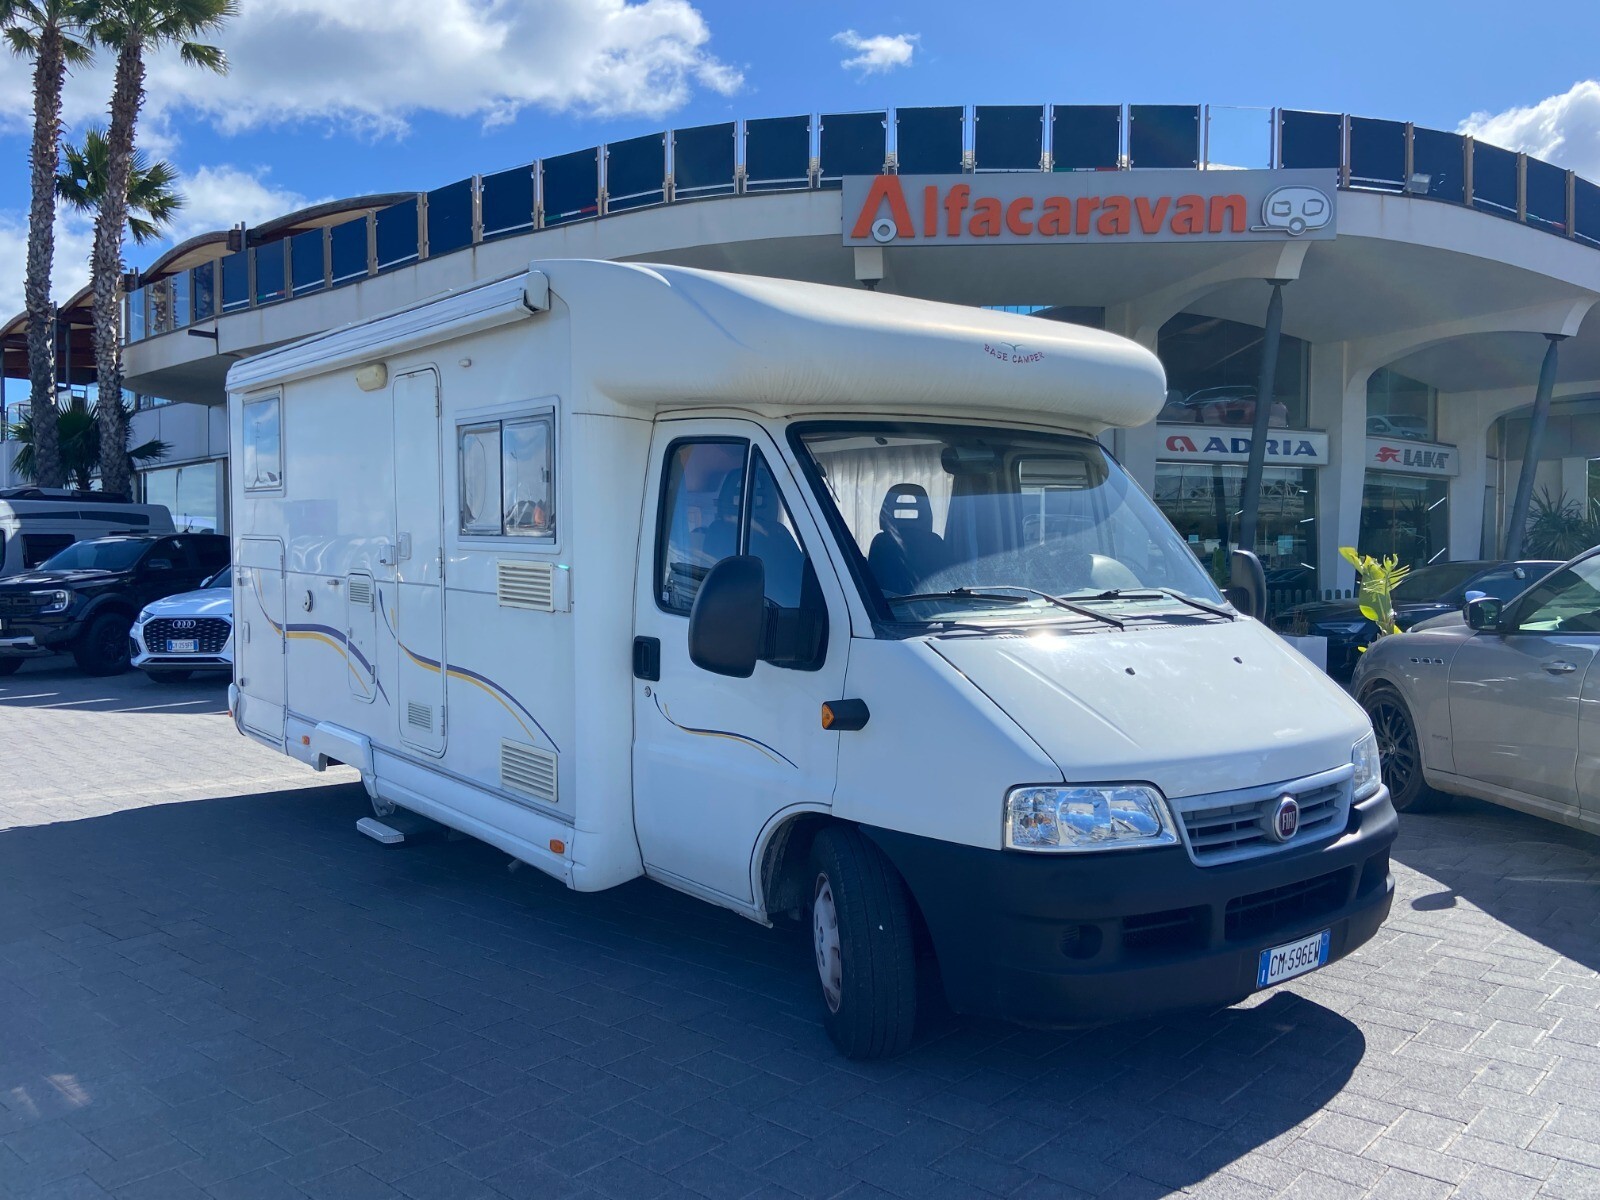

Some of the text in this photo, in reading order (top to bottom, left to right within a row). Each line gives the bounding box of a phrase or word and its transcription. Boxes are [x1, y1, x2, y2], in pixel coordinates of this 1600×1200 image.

[851, 175, 1247, 240] Alfacaravan
[984, 343, 1045, 364] BASE CAMPER
[1203, 436, 1318, 457] ADRIA
[1282, 810, 1296, 831] FIAT
